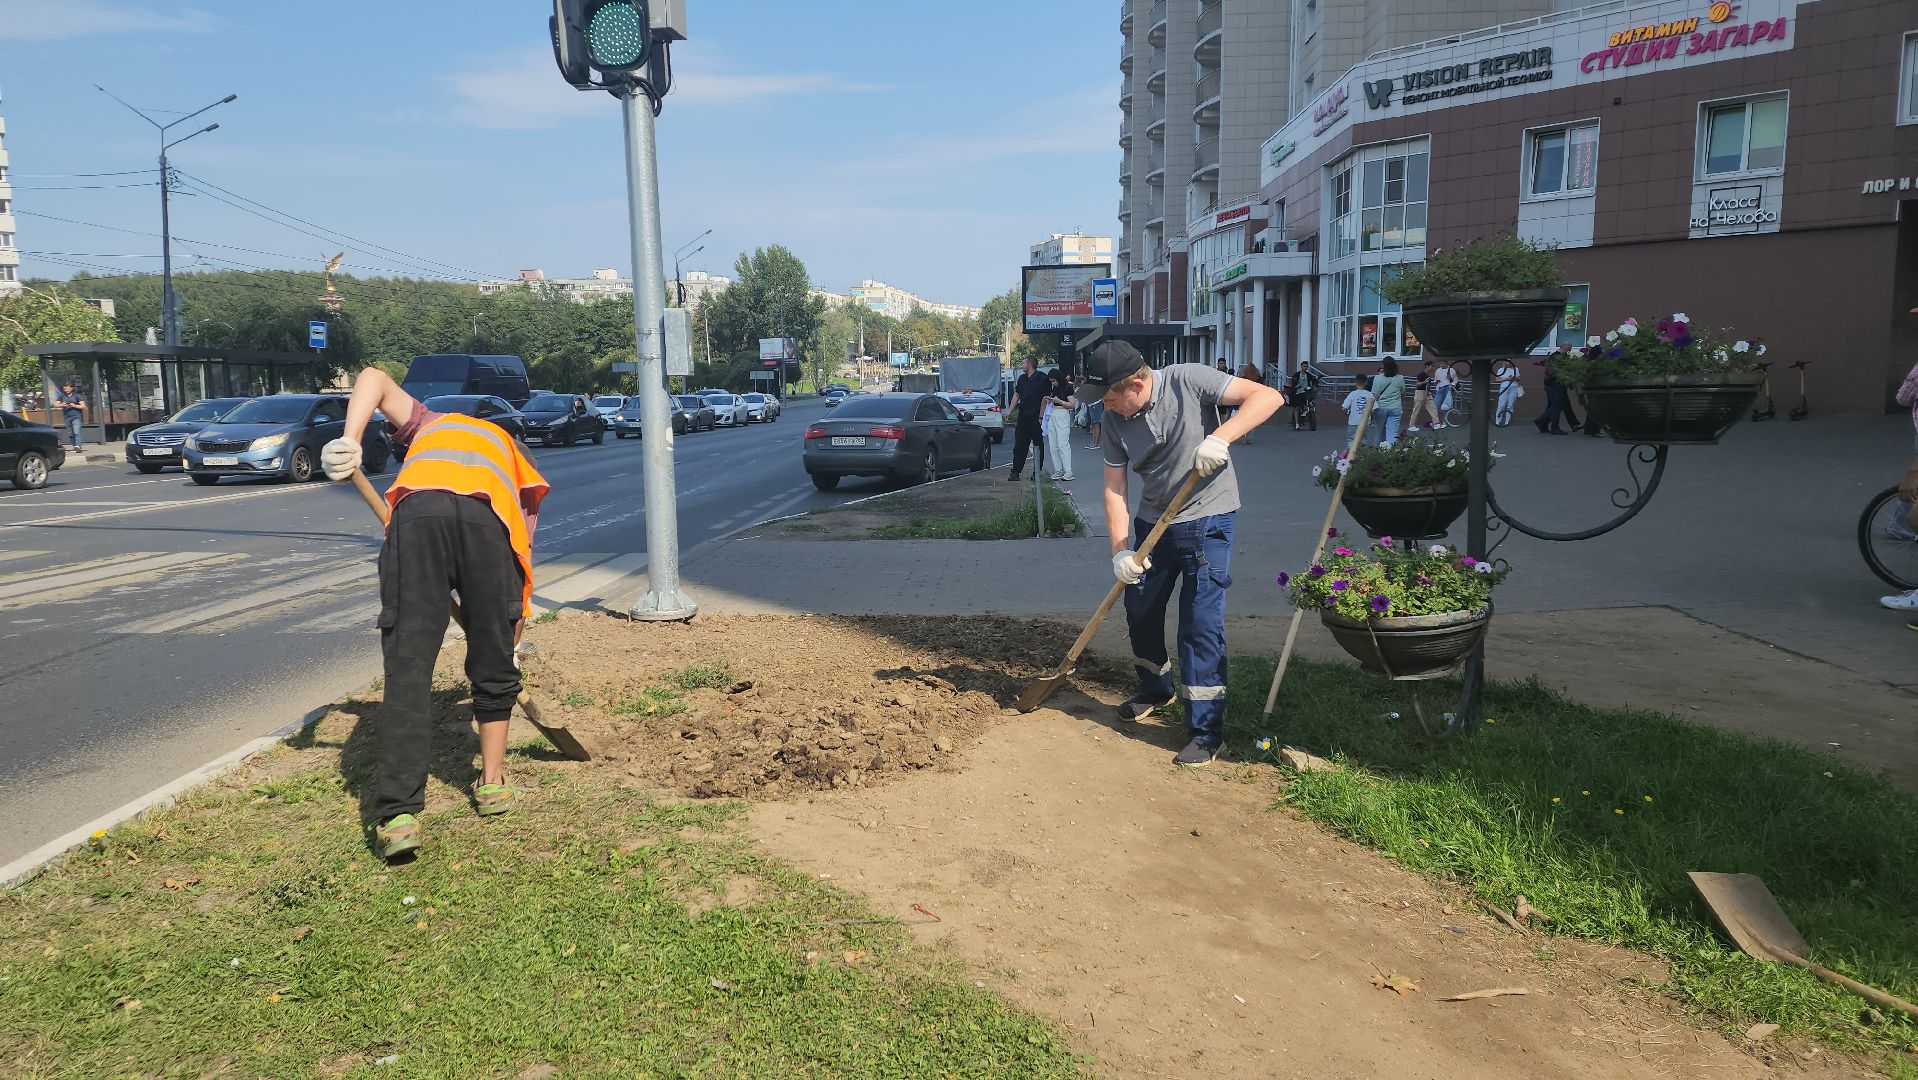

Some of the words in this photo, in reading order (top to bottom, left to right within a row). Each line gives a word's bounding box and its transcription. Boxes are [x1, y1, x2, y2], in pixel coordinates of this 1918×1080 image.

[1580, 36, 1681, 74] СТУДИЯ
[1685, 17, 1787, 56] ЗАГАРА
[1608, 16, 1700, 48] ВИТАМИН
[1403, 63, 1470, 92] VISION
[1479, 46, 1553, 77] REPAIR
[1403, 91, 1440, 106] РЕМОНТ
[1440, 76, 1505, 98] МОБИЛЬНОЙ
[1505, 69, 1553, 88] ТЕХНИКИ
[1861, 178, 1895, 194] ЛОР
[1899, 176, 1910, 190] И
[1689, 217, 1709, 229] на
[1716, 208, 1777, 225] Чехова
[1709, 196, 1758, 211] Класс
